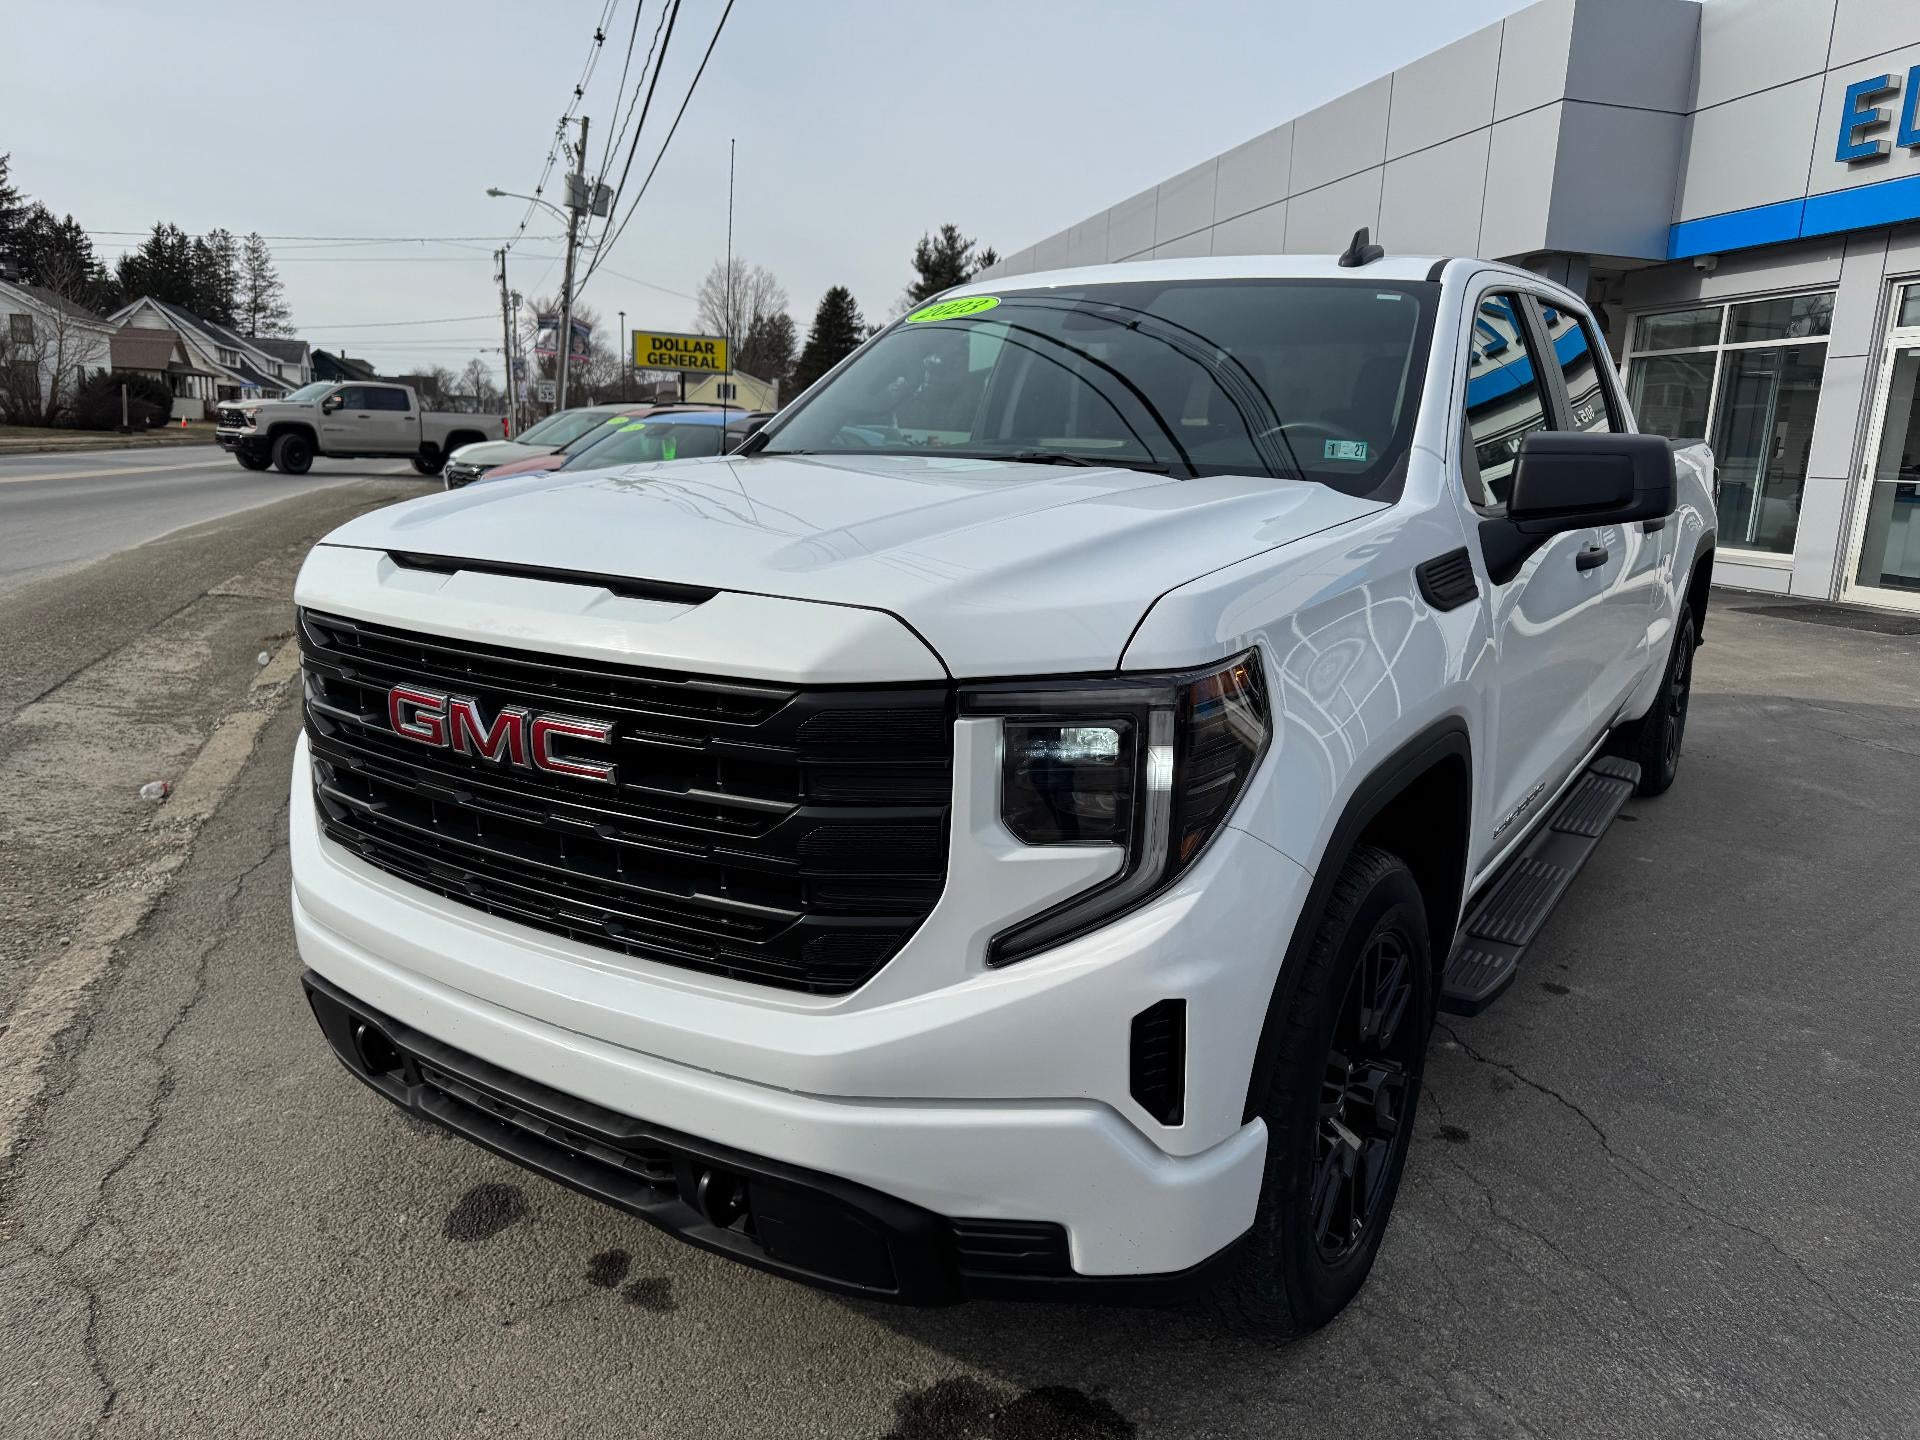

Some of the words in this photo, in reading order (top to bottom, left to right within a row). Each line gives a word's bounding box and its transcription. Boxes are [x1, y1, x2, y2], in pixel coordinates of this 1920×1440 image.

[651, 337, 715, 354] DOLLAR
[647, 352, 720, 369] GENERAL
[1354, 443, 1365, 457] 27
[388, 683, 617, 785] GMC
